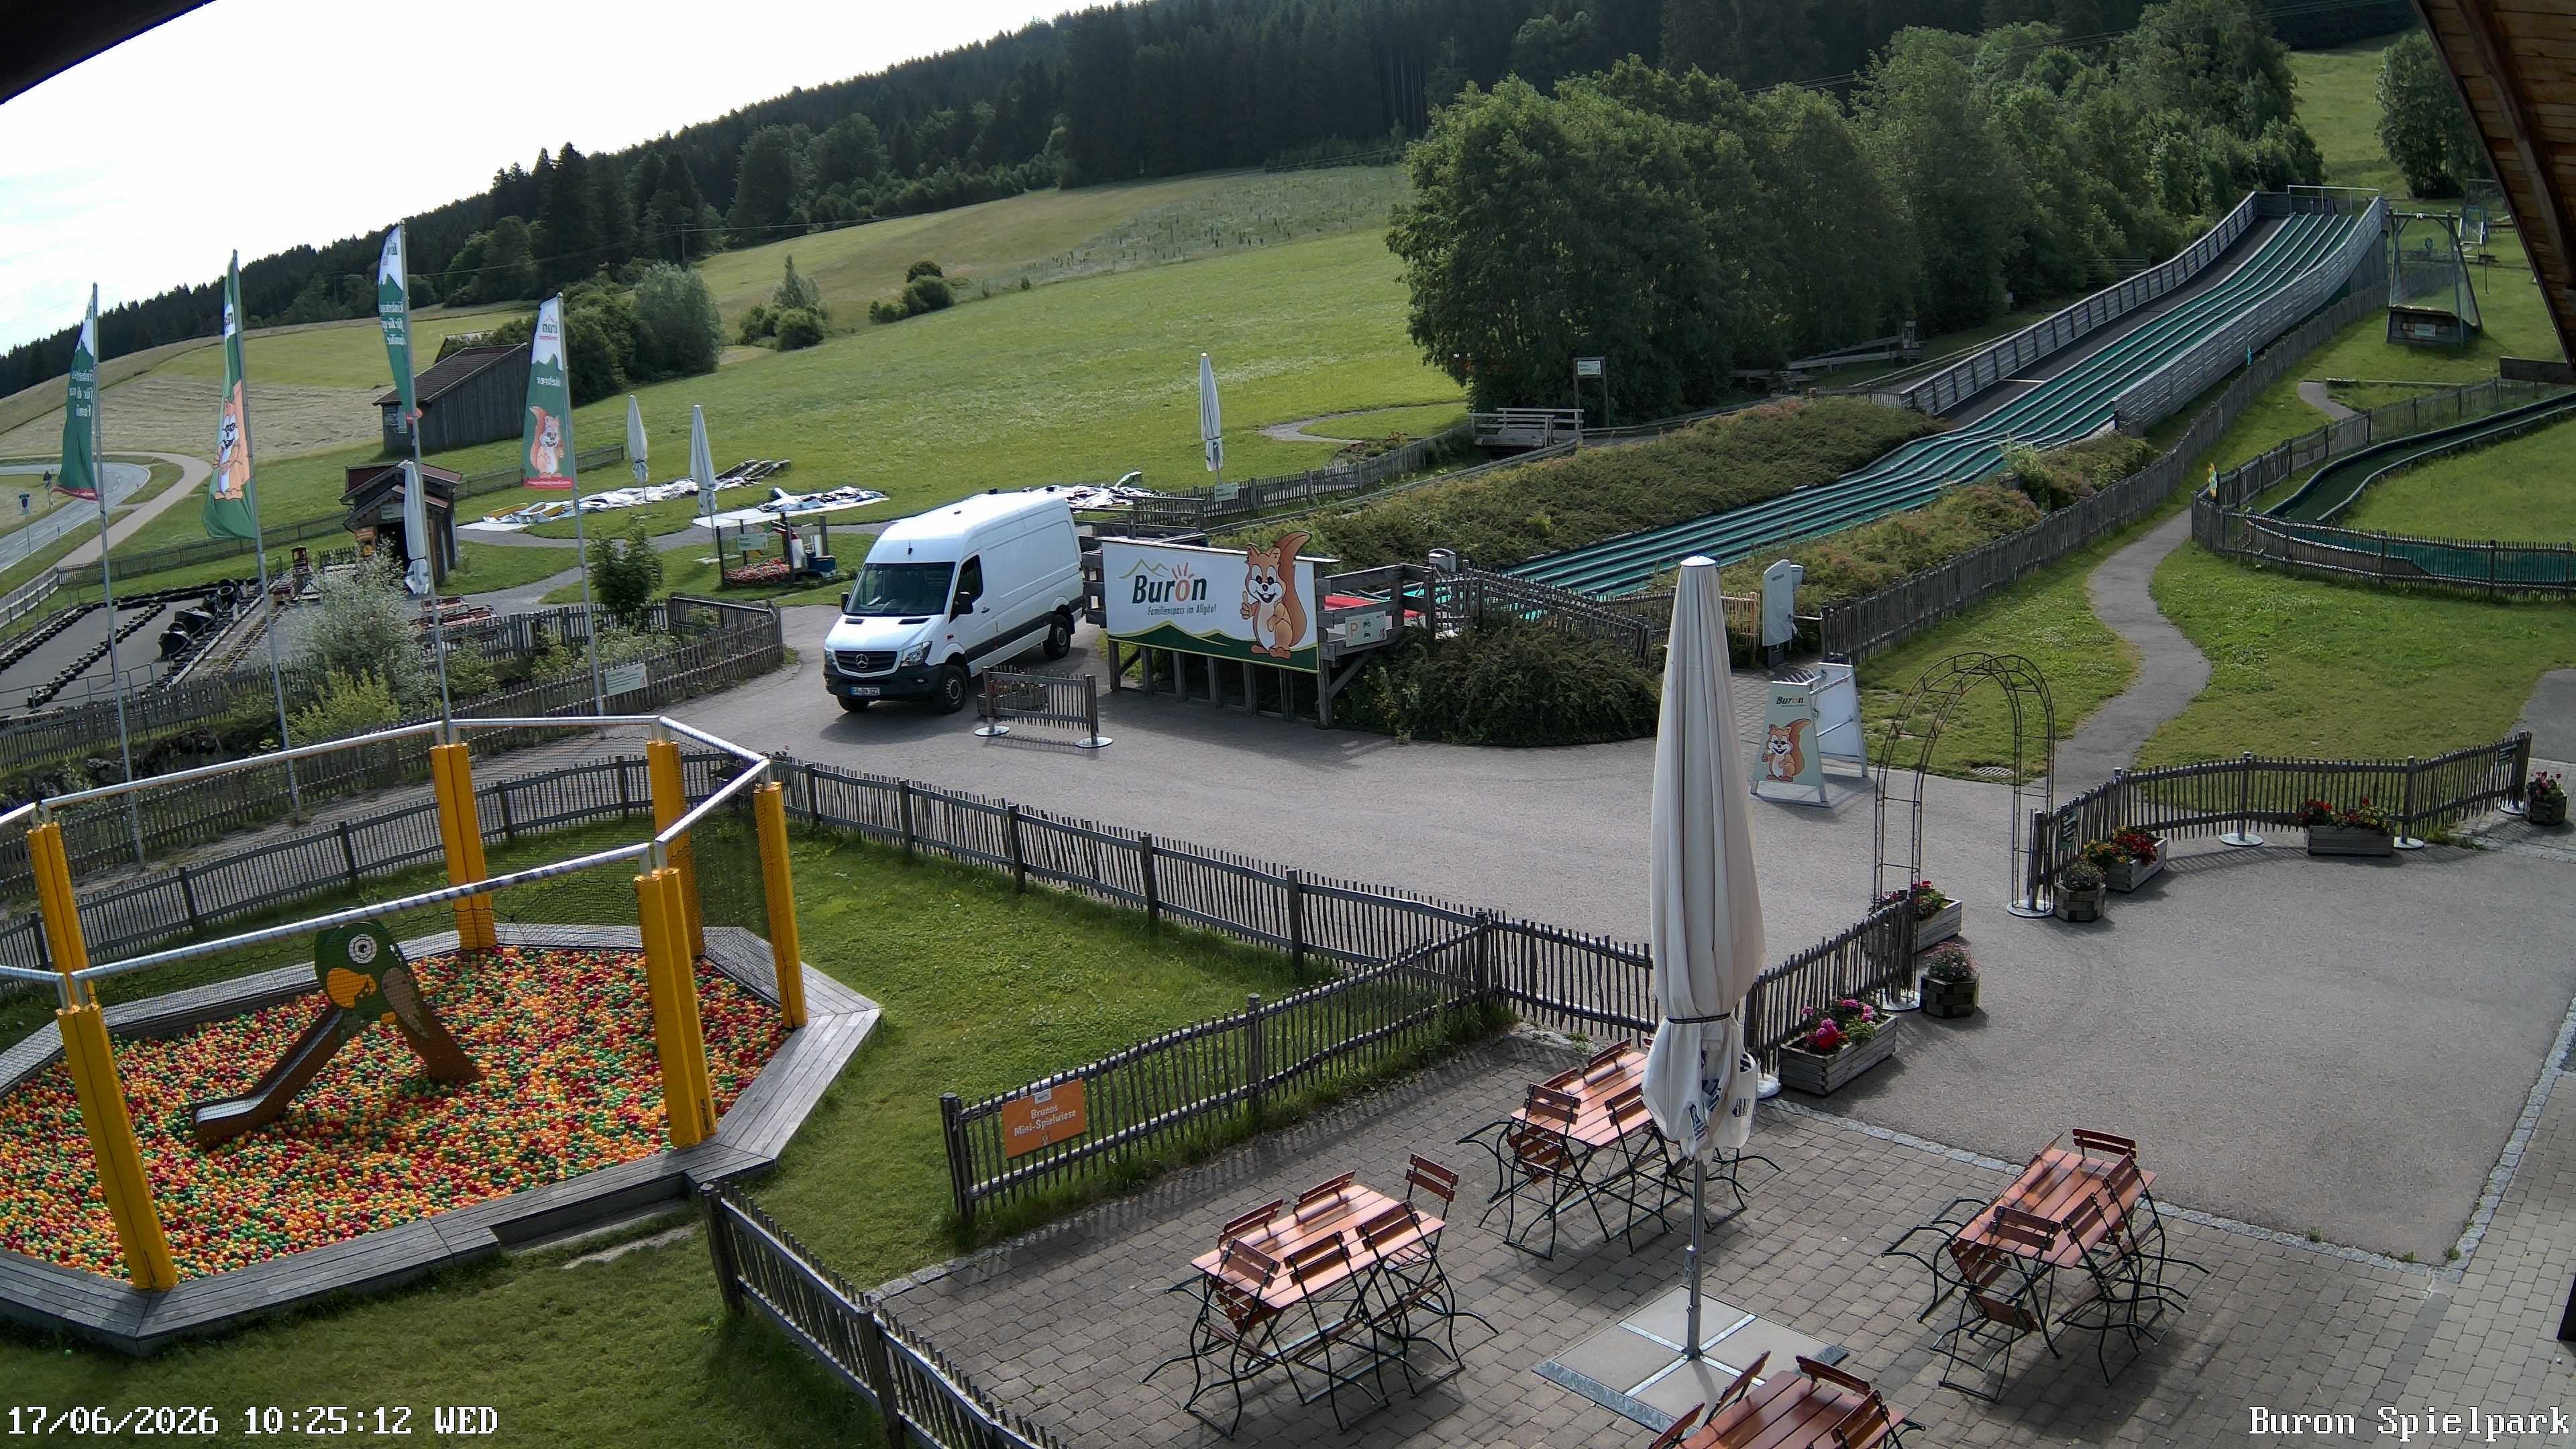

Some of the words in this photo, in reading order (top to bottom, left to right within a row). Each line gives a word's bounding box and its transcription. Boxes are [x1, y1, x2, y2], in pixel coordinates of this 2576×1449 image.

[1132, 575, 1207, 604] Buron
[1350, 622, 1358, 638] P
[1776, 696, 1804, 704] Buron
